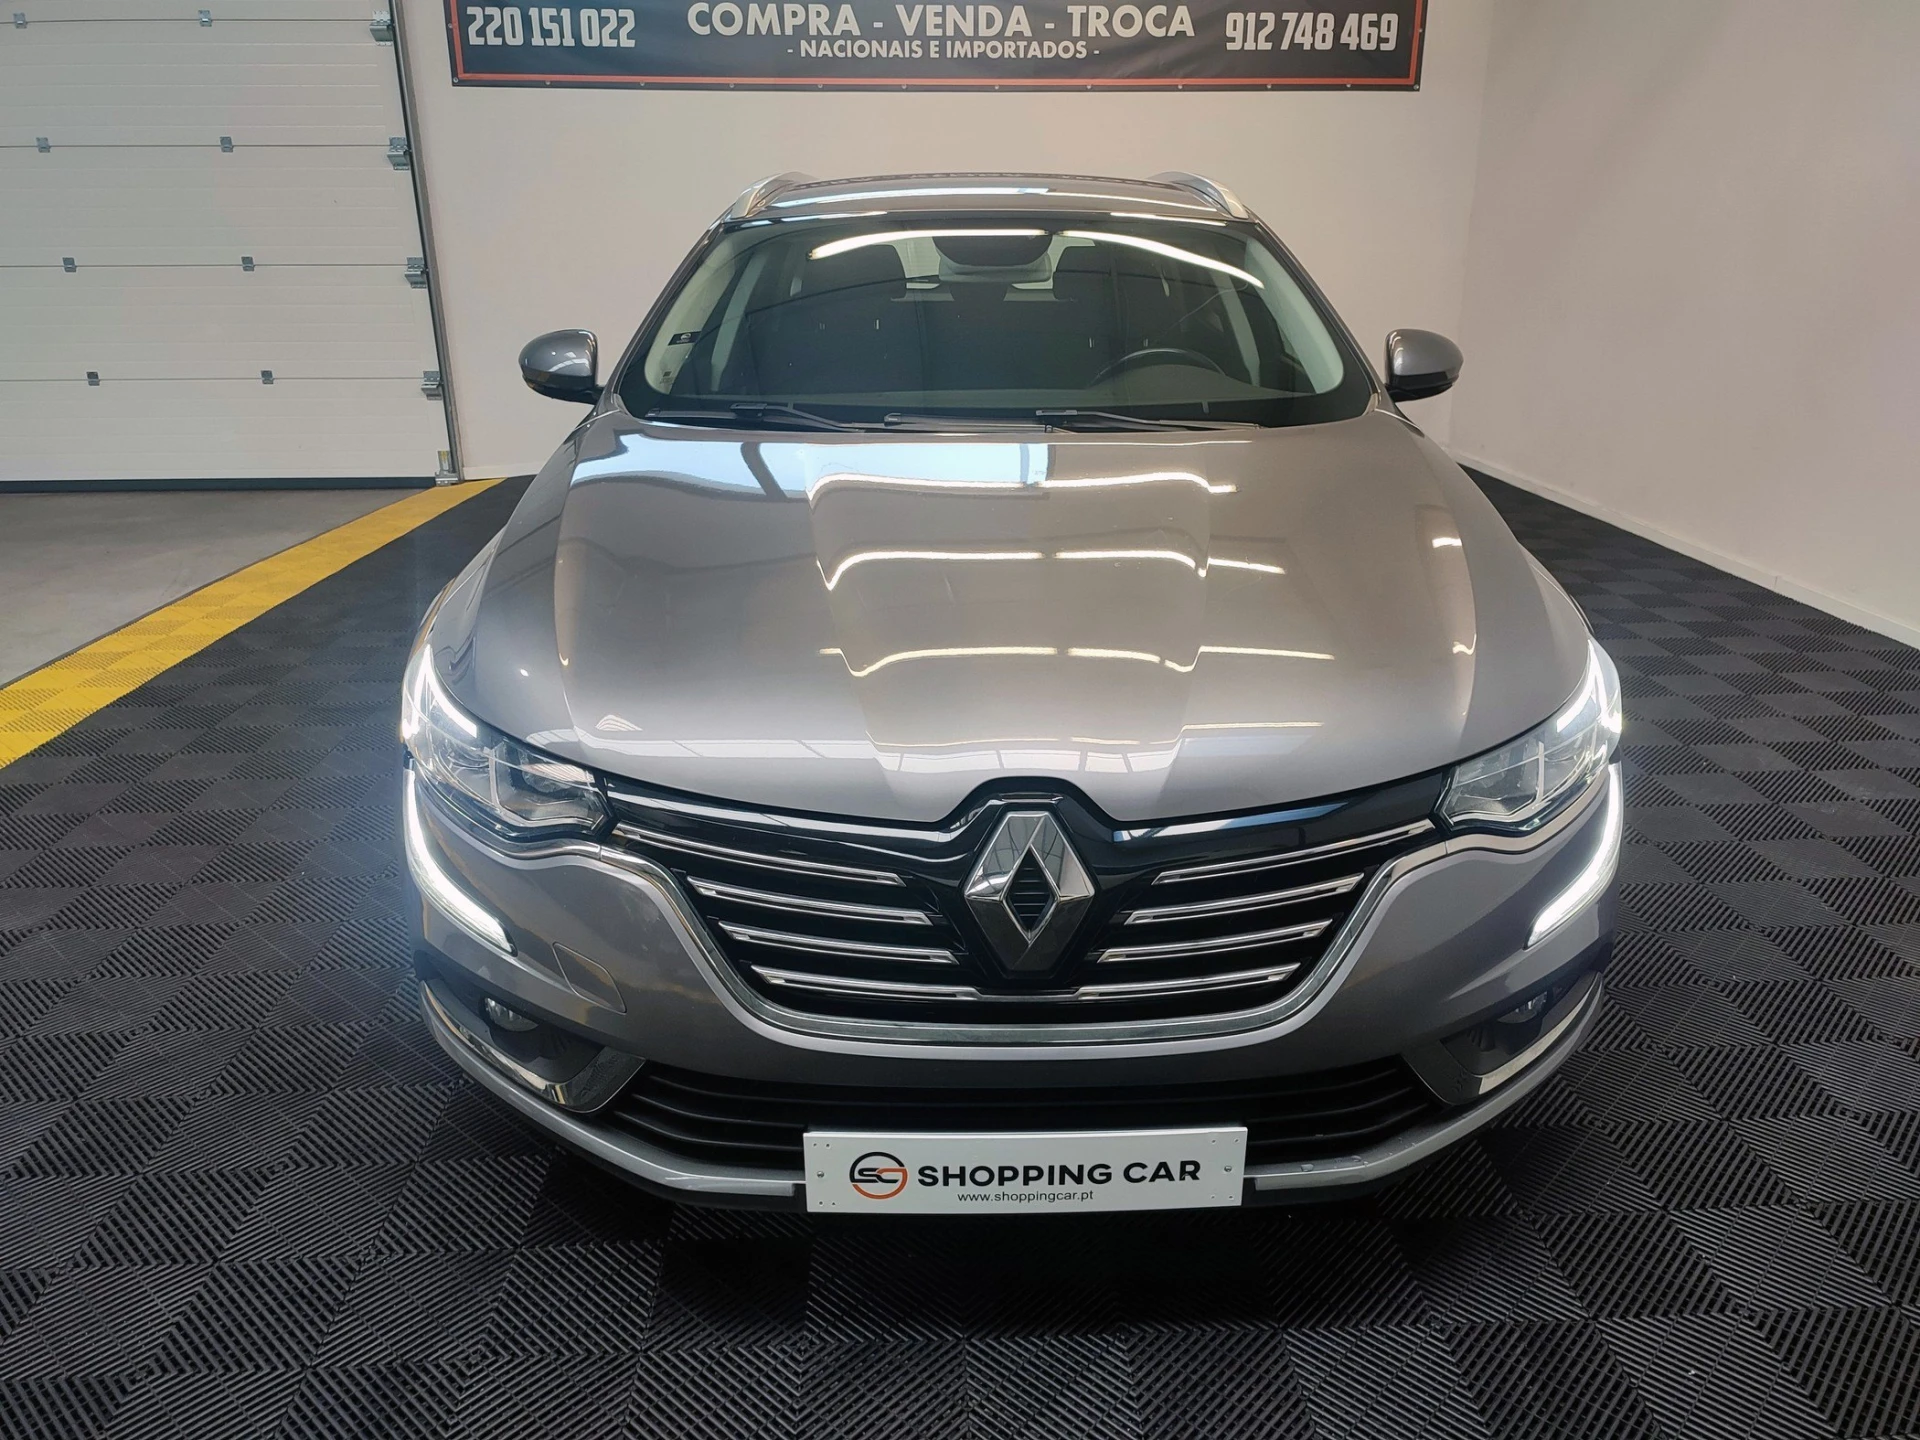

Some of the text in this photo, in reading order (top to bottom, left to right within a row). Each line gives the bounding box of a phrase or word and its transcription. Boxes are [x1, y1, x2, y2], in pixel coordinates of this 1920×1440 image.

[466, 6, 636, 48] 220 151 022
[687, 2, 861, 36] COMPRA
[895, 4, 1033, 37] VENDA
[1067, 5, 1195, 38] TROCA
[1225, 12, 1399, 51] 912 748 469
[800, 40, 922, 58] NACIONAIS
[929, 41, 940, 59] E
[946, 41, 1087, 59] IMPORTADOS
[917, 1160, 1201, 1187] SHOPPING CAR
[957, 1190, 1094, 1204] www.shoppingcar.pt
